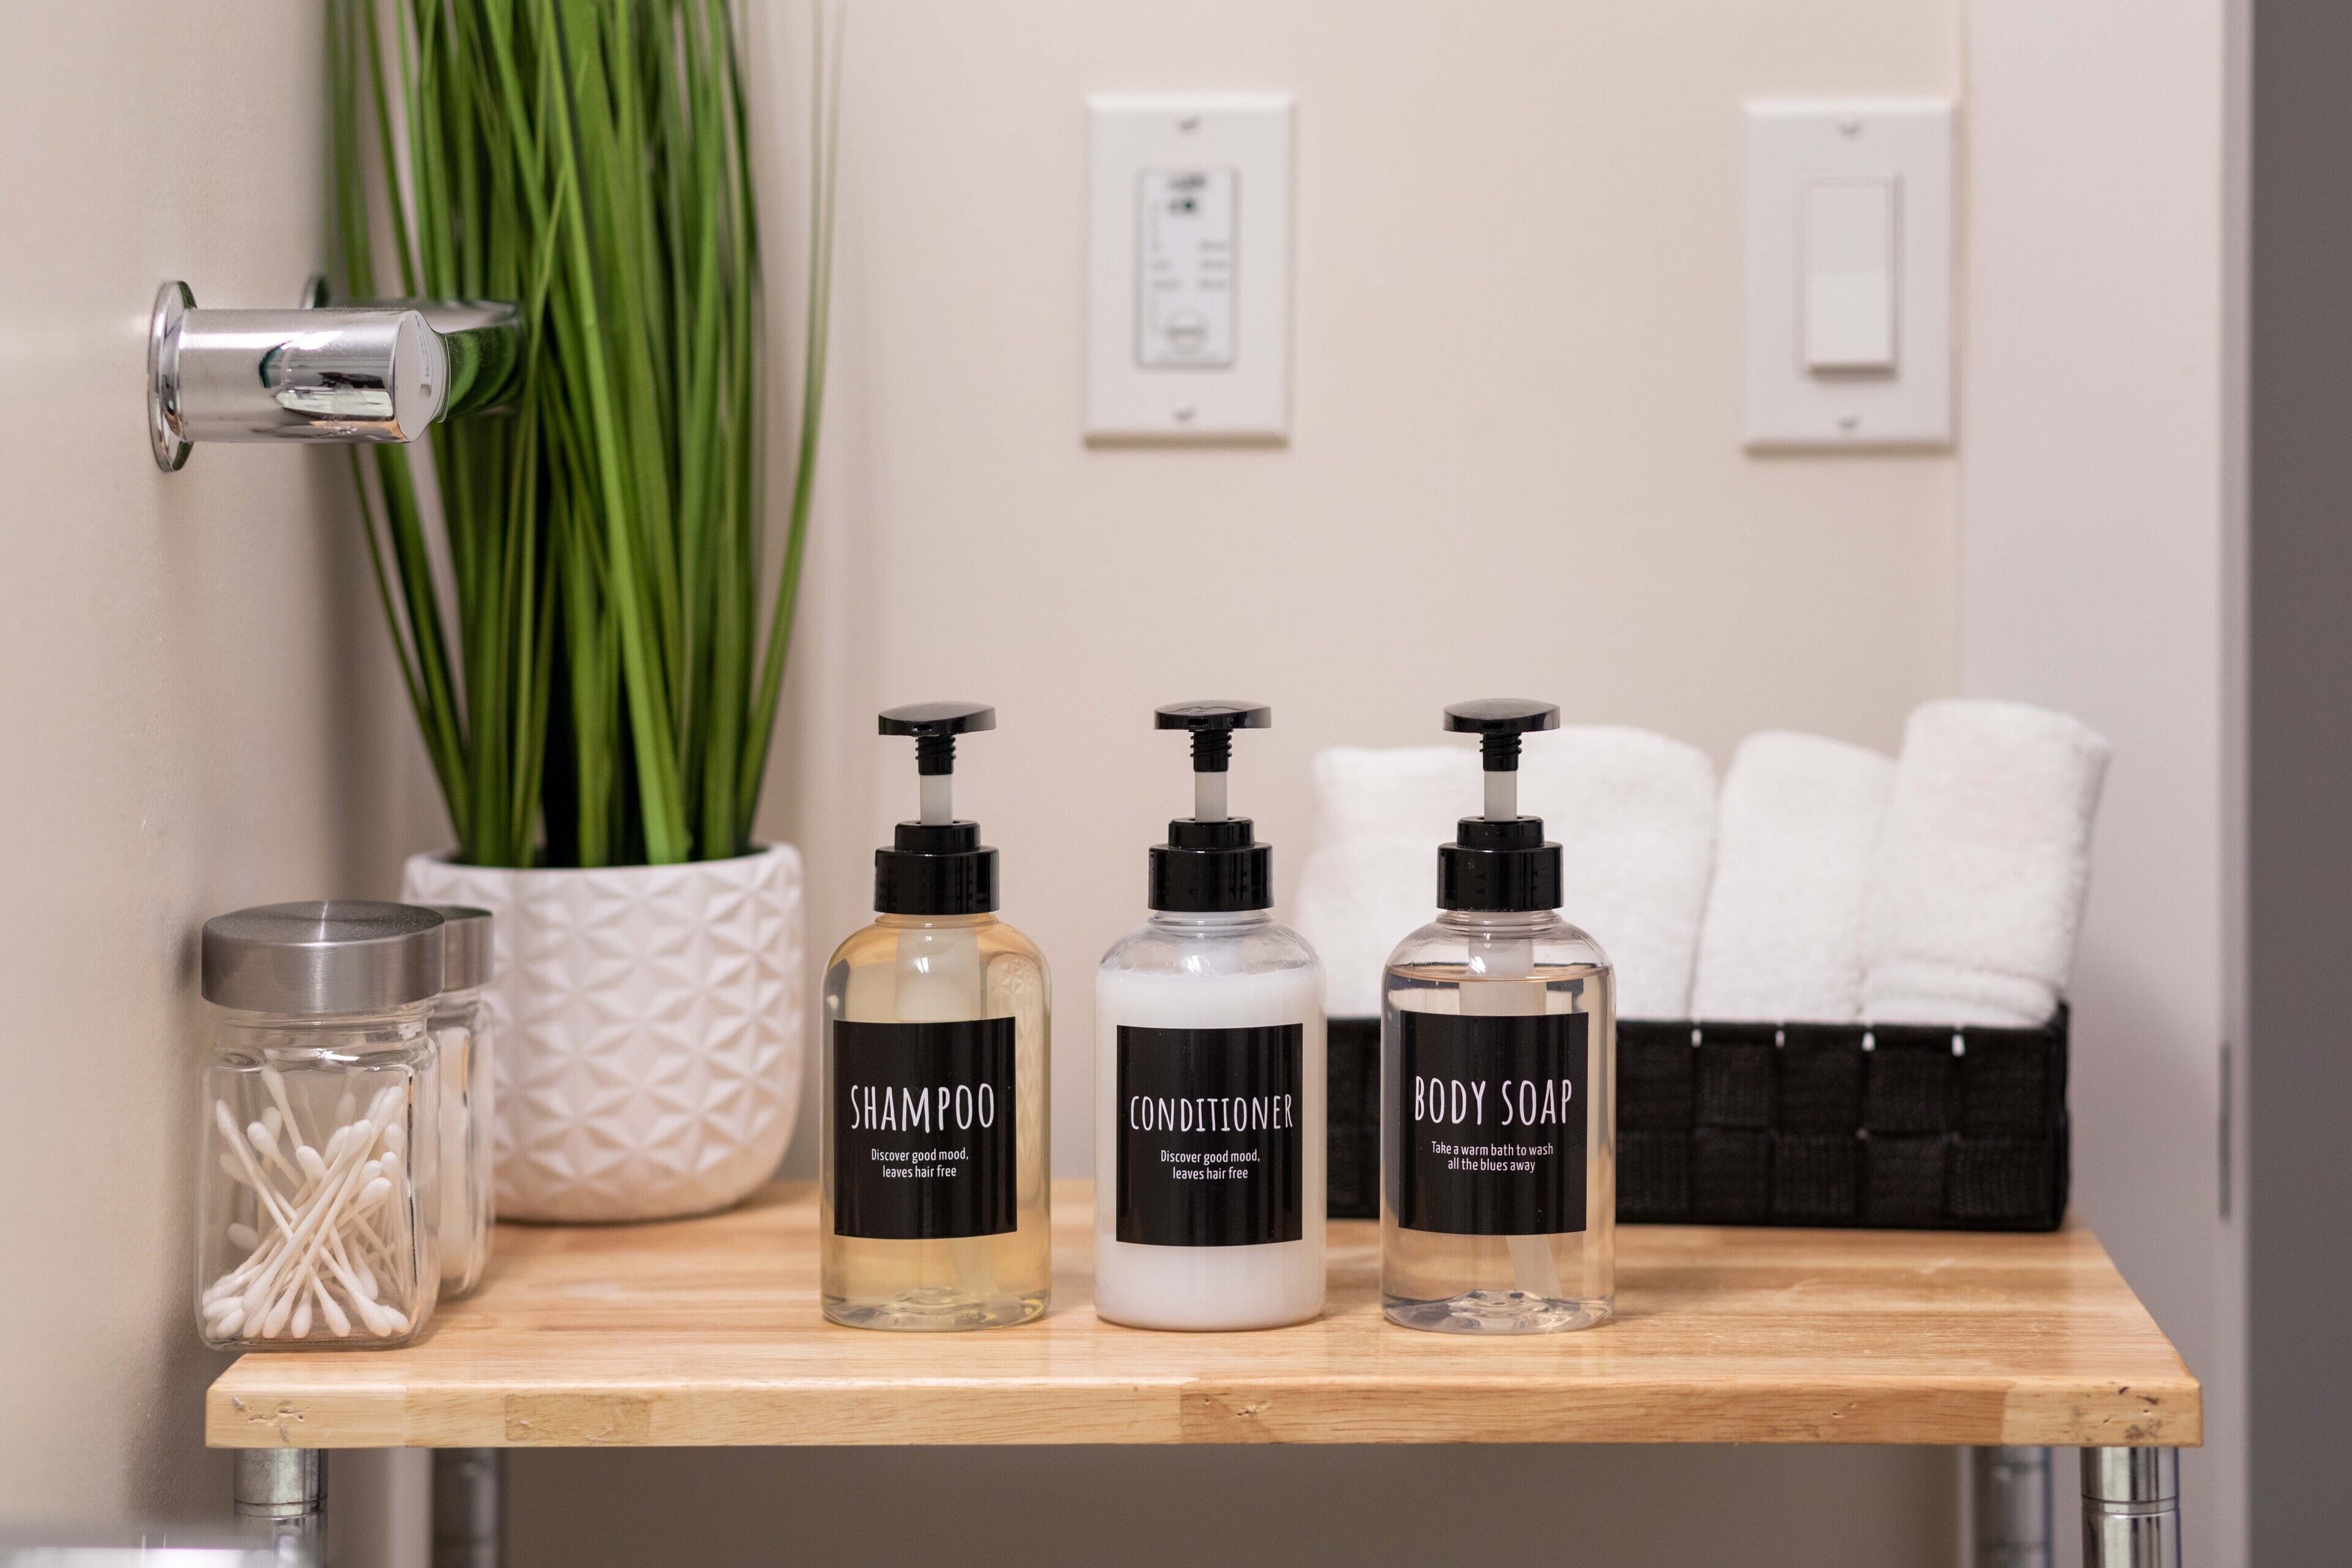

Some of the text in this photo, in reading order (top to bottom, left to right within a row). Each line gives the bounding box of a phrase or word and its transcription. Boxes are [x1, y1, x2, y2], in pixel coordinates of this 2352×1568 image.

[851, 1083, 994, 1134] SHAMPOO
[1415, 1076, 1572, 1126] BODY SOAP
[1131, 1094, 1293, 1132] CONDITIONER
[871, 1147, 969, 1164] Discover good mood,
[1161, 1148, 1260, 1166] Discover good mood,
[1431, 1140, 1553, 1156] Take a warm bath to wash
[883, 1164, 957, 1178] leaves hair free
[1173, 1166, 1248, 1180] leaves hair free
[1448, 1156, 1536, 1174] all the blues away
